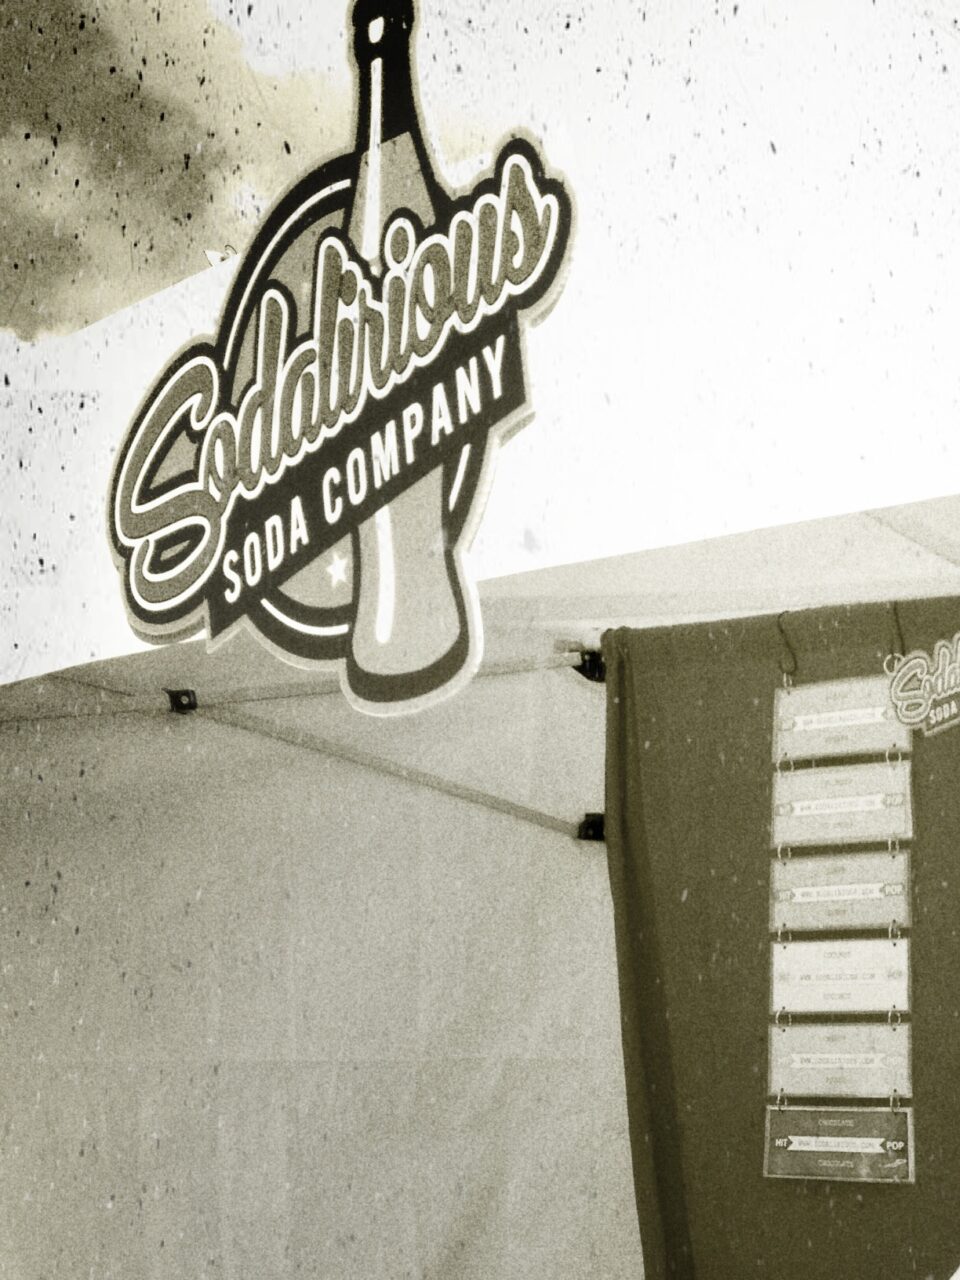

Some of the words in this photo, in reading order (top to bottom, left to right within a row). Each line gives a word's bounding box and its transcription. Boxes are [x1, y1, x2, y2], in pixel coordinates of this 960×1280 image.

[115, 155, 559, 611] Sodalirious
[224, 497, 309, 602] SODA
[322, 336, 505, 523] COMPANY
[929, 701, 958, 724] SODA
[886, 1141, 905, 1151] POP
